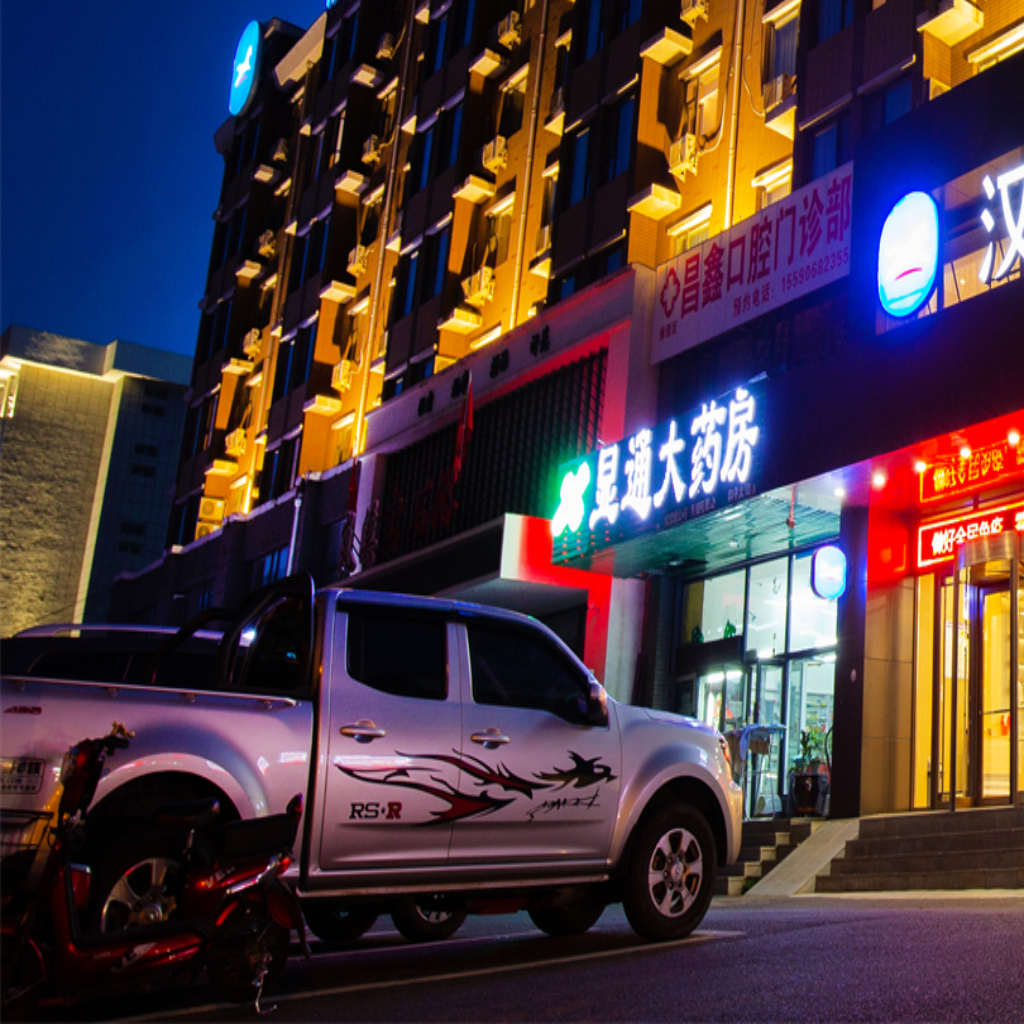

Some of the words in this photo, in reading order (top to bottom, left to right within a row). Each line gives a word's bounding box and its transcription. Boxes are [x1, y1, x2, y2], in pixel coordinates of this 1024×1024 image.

[680, 175, 852, 319] 昌鑫口腔门诊部
